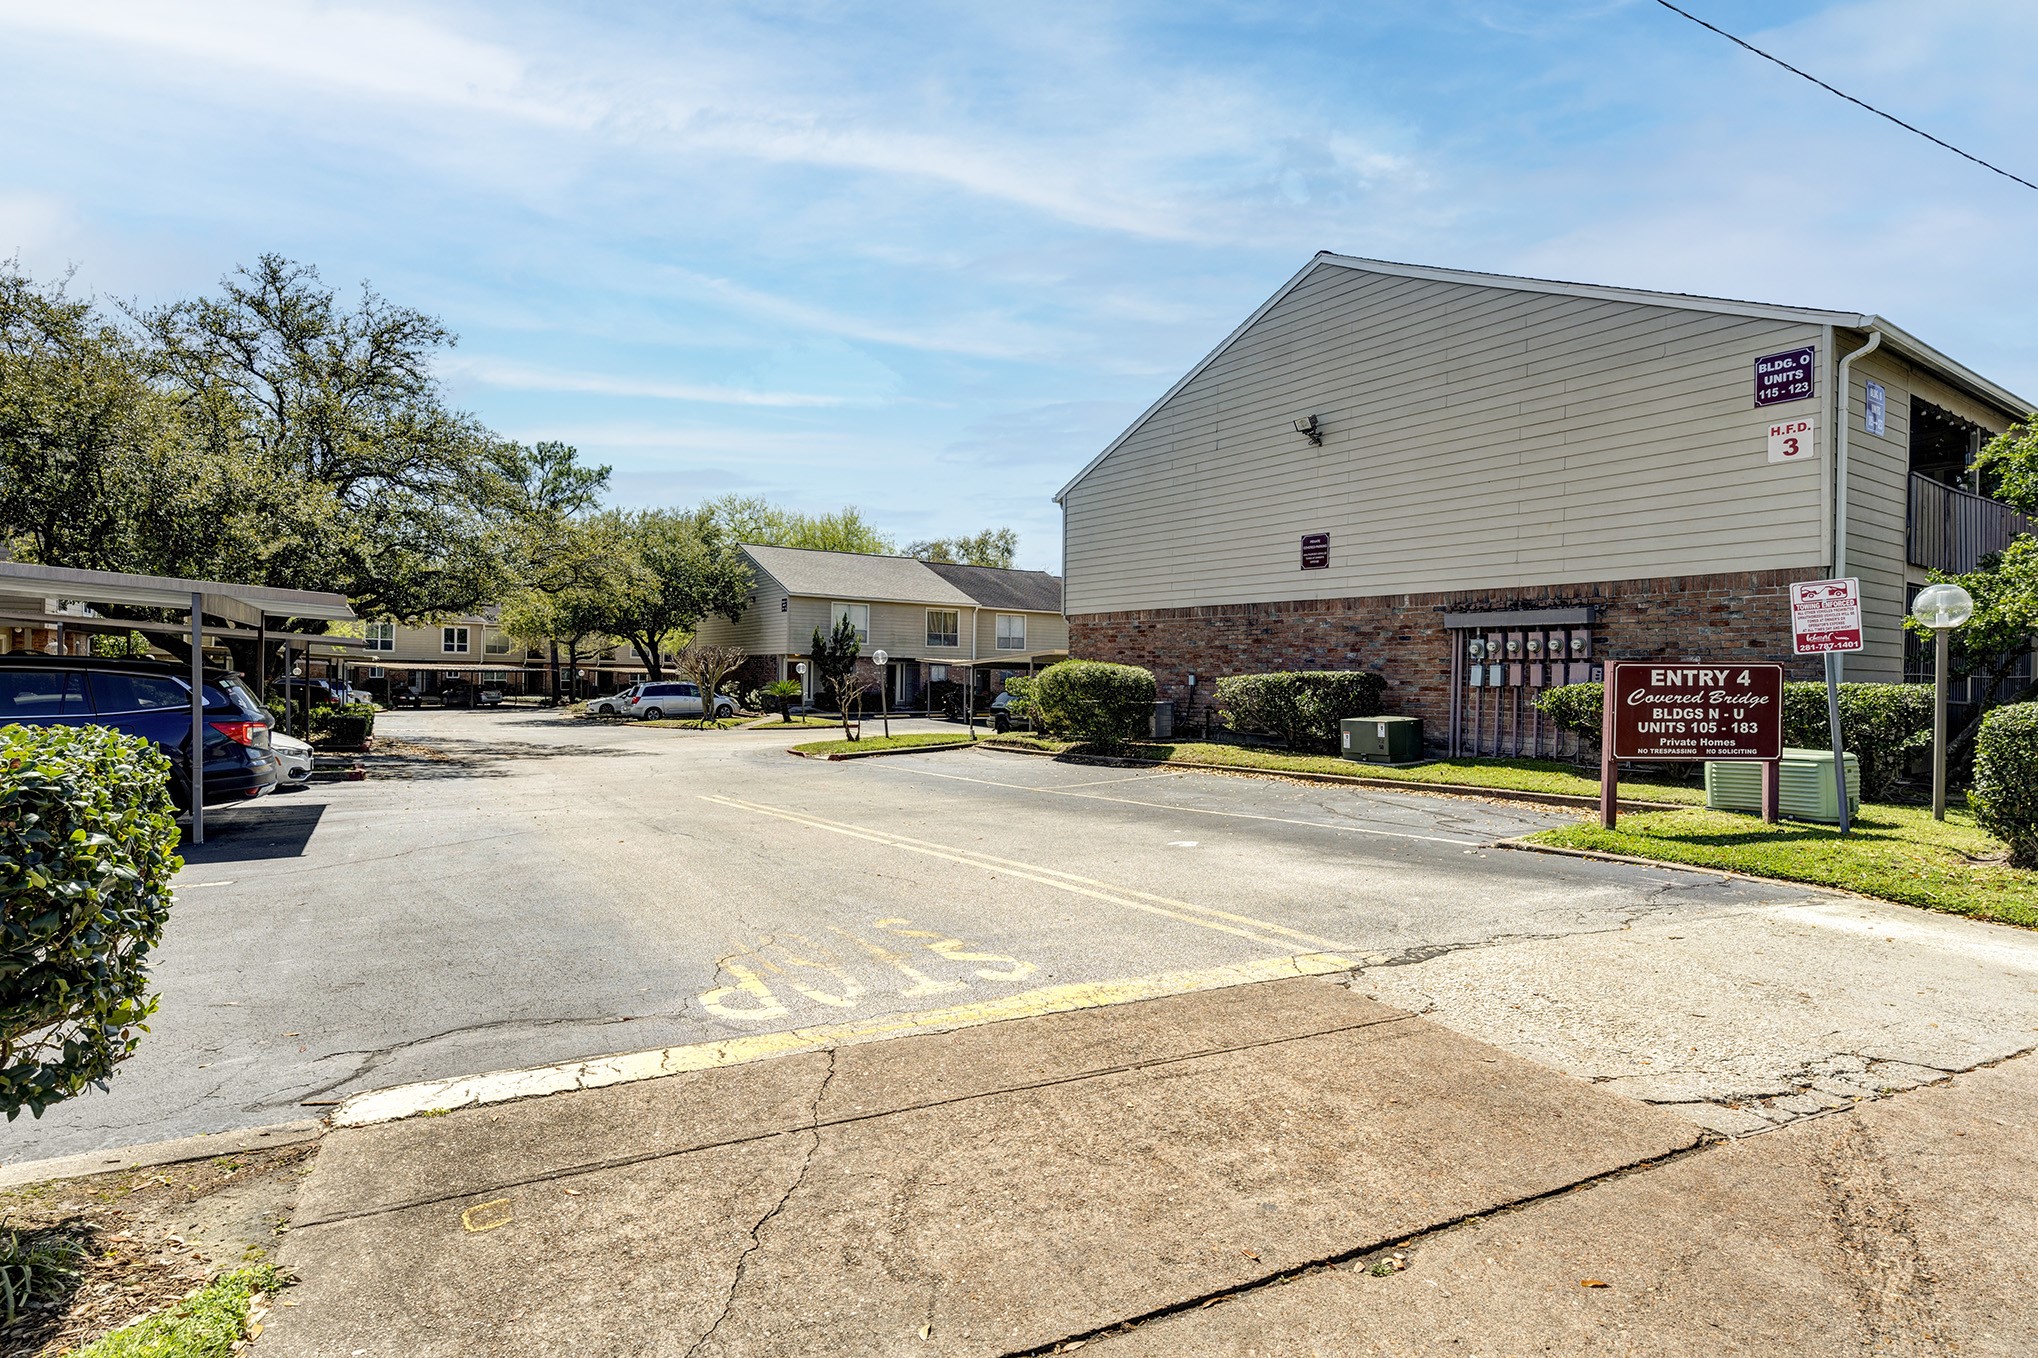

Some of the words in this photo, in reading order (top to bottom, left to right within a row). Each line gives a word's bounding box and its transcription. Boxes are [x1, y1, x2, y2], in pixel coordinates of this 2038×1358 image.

[1758, 358, 1796, 374] BLDG.
[1799, 354, 1810, 365] O
[1764, 369, 1804, 385] UNITS
[1759, 387, 1779, 400] 115
[1788, 381, 1809, 395] 123
[1770, 422, 1811, 437] H.F.D.
[1782, 437, 1799, 457] 3
[1796, 602, 1821, 611] TOWING
[1822, 599, 1855, 608] ENFORCED
[1799, 641, 1859, 652] 281-787-1401
[1651, 669, 1730, 686] ENTRY
[1736, 669, 1751, 686] 4
[1627, 688, 1704, 706] Covered
[1708, 690, 1769, 708] Bridge
[1652, 708, 1704, 719] BLDGS
[1708, 708, 1719, 719] N
[1733, 708, 1744, 719] U
[1637, 722, 1686, 733] UNITS
[1691, 722, 1717, 733] 105
[1731, 722, 1758, 733] 183
[1660, 737, 1697, 746] Private
[1700, 737, 1736, 746] Homes
